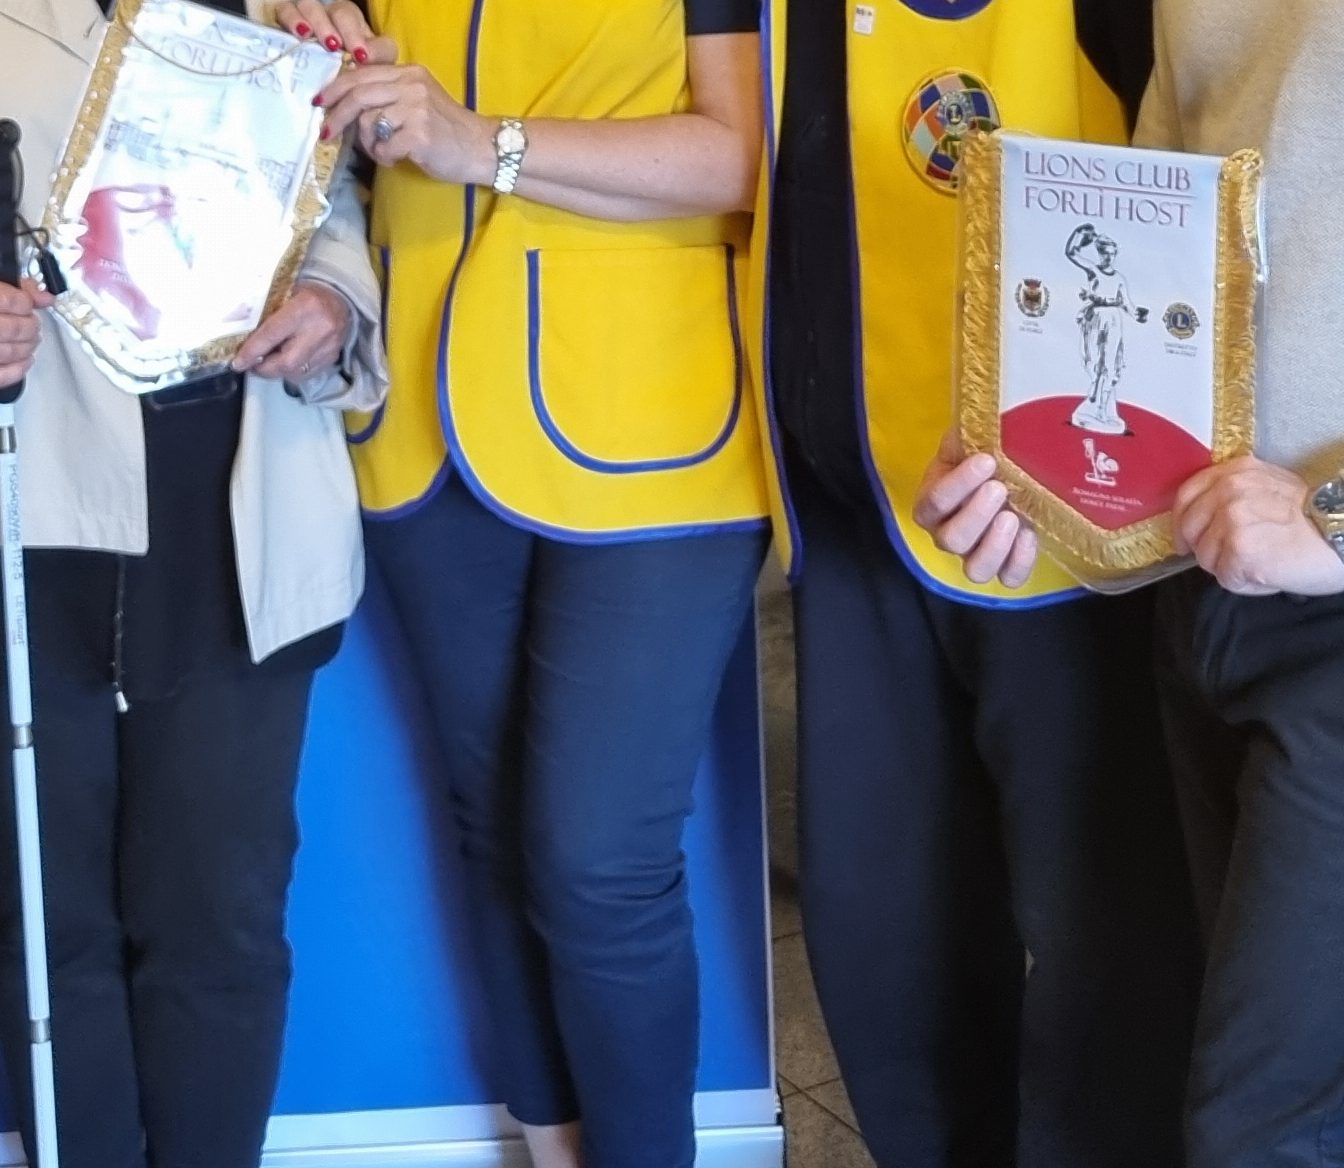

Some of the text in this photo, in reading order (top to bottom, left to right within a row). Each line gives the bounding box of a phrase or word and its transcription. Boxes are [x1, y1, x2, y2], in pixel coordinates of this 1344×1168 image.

[1025, 150, 1192, 192] LIONS CLUB
[1114, 196, 1193, 228] HOST
